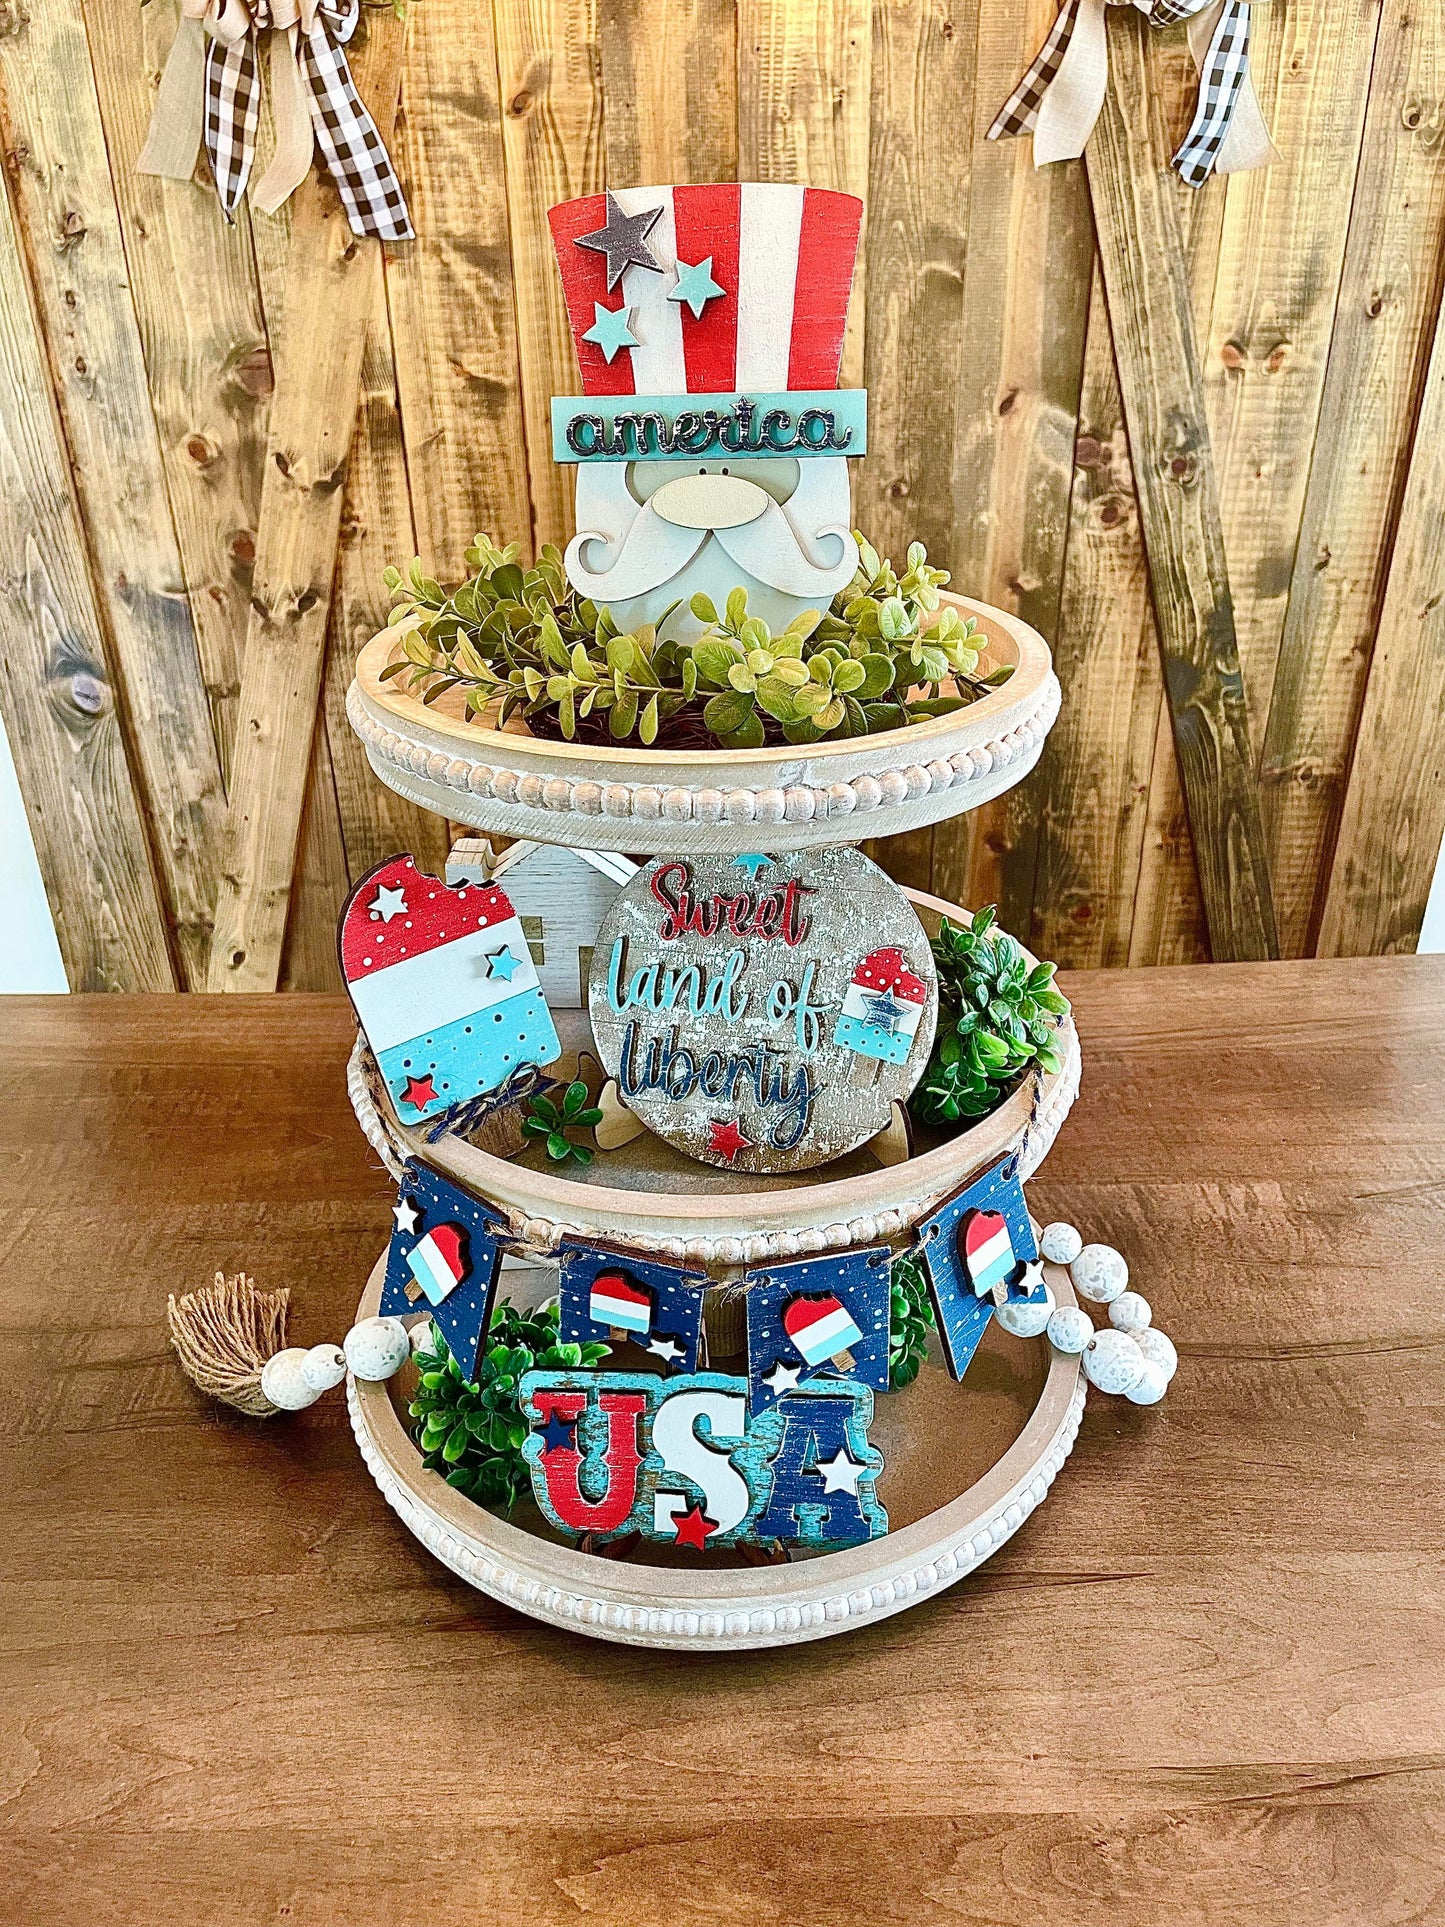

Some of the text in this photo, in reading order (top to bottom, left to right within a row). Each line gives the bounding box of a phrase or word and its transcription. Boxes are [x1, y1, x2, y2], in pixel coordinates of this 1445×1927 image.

[566, 396, 852, 455] america
[651, 862, 818, 947] Sweet
[607, 937, 840, 1054] land of
[619, 1020, 826, 1150] liberty
[531, 1388, 873, 1538] USA
